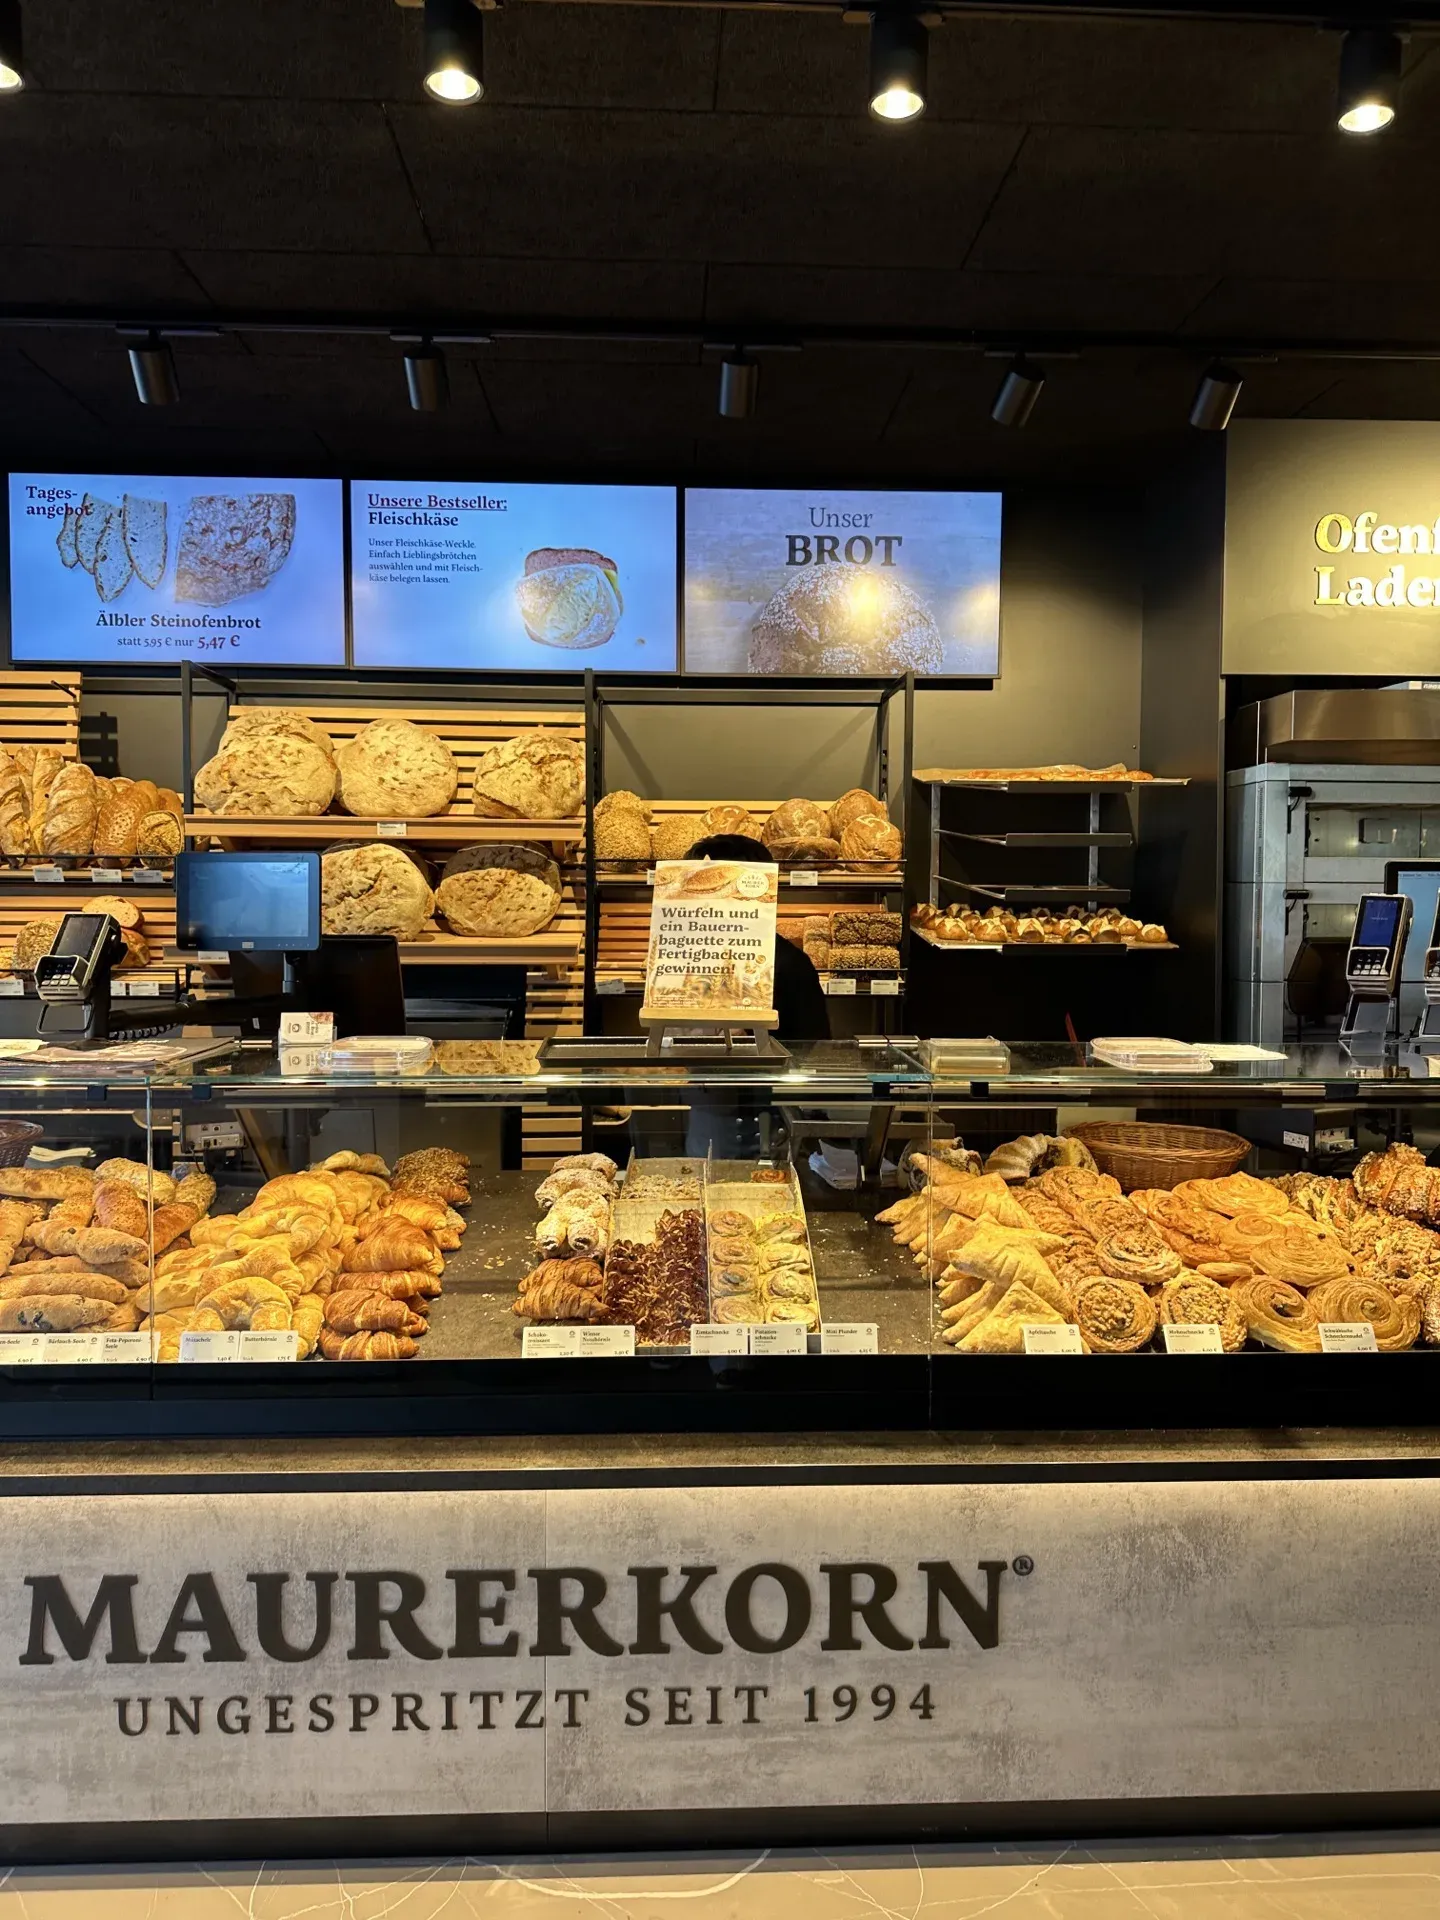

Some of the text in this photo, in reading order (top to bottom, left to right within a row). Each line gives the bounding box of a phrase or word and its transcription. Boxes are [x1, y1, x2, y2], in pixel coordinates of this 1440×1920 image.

[26, 486, 78, 501] Tages-
[368, 494, 508, 511] Unsere Bestseller:
[26, 502, 91, 519] angebot
[808, 507, 873, 528] Unser
[368, 512, 459, 527] Fleischkäse
[368, 538, 393, 547] Unser
[369, 550, 477, 562] Einfach Lieblingsbrötchen
[785, 534, 902, 567] BROT
[369, 562, 483, 573] auswählen und mit Fleisch-
[369, 573, 388, 583] käse
[390, 573, 421, 585] belegen
[96, 611, 261, 629] Älbler Steinofenbrot
[117, 636, 141, 647] statt
[165, 637, 172, 646] €
[175, 638, 194, 647] nur
[197, 636, 226, 650] 5,47
[230, 634, 240, 647] €
[662, 907, 759, 919] Würfeln und
[660, 921, 750, 933] ein Bauern-
[658, 935, 762, 949] baguette zum
[658, 948, 756, 962] Fertigbacken
[656, 964, 735, 977] gewinnen!
[114, 1683, 936, 1736] UNGESPRITZT SEIT 1994
